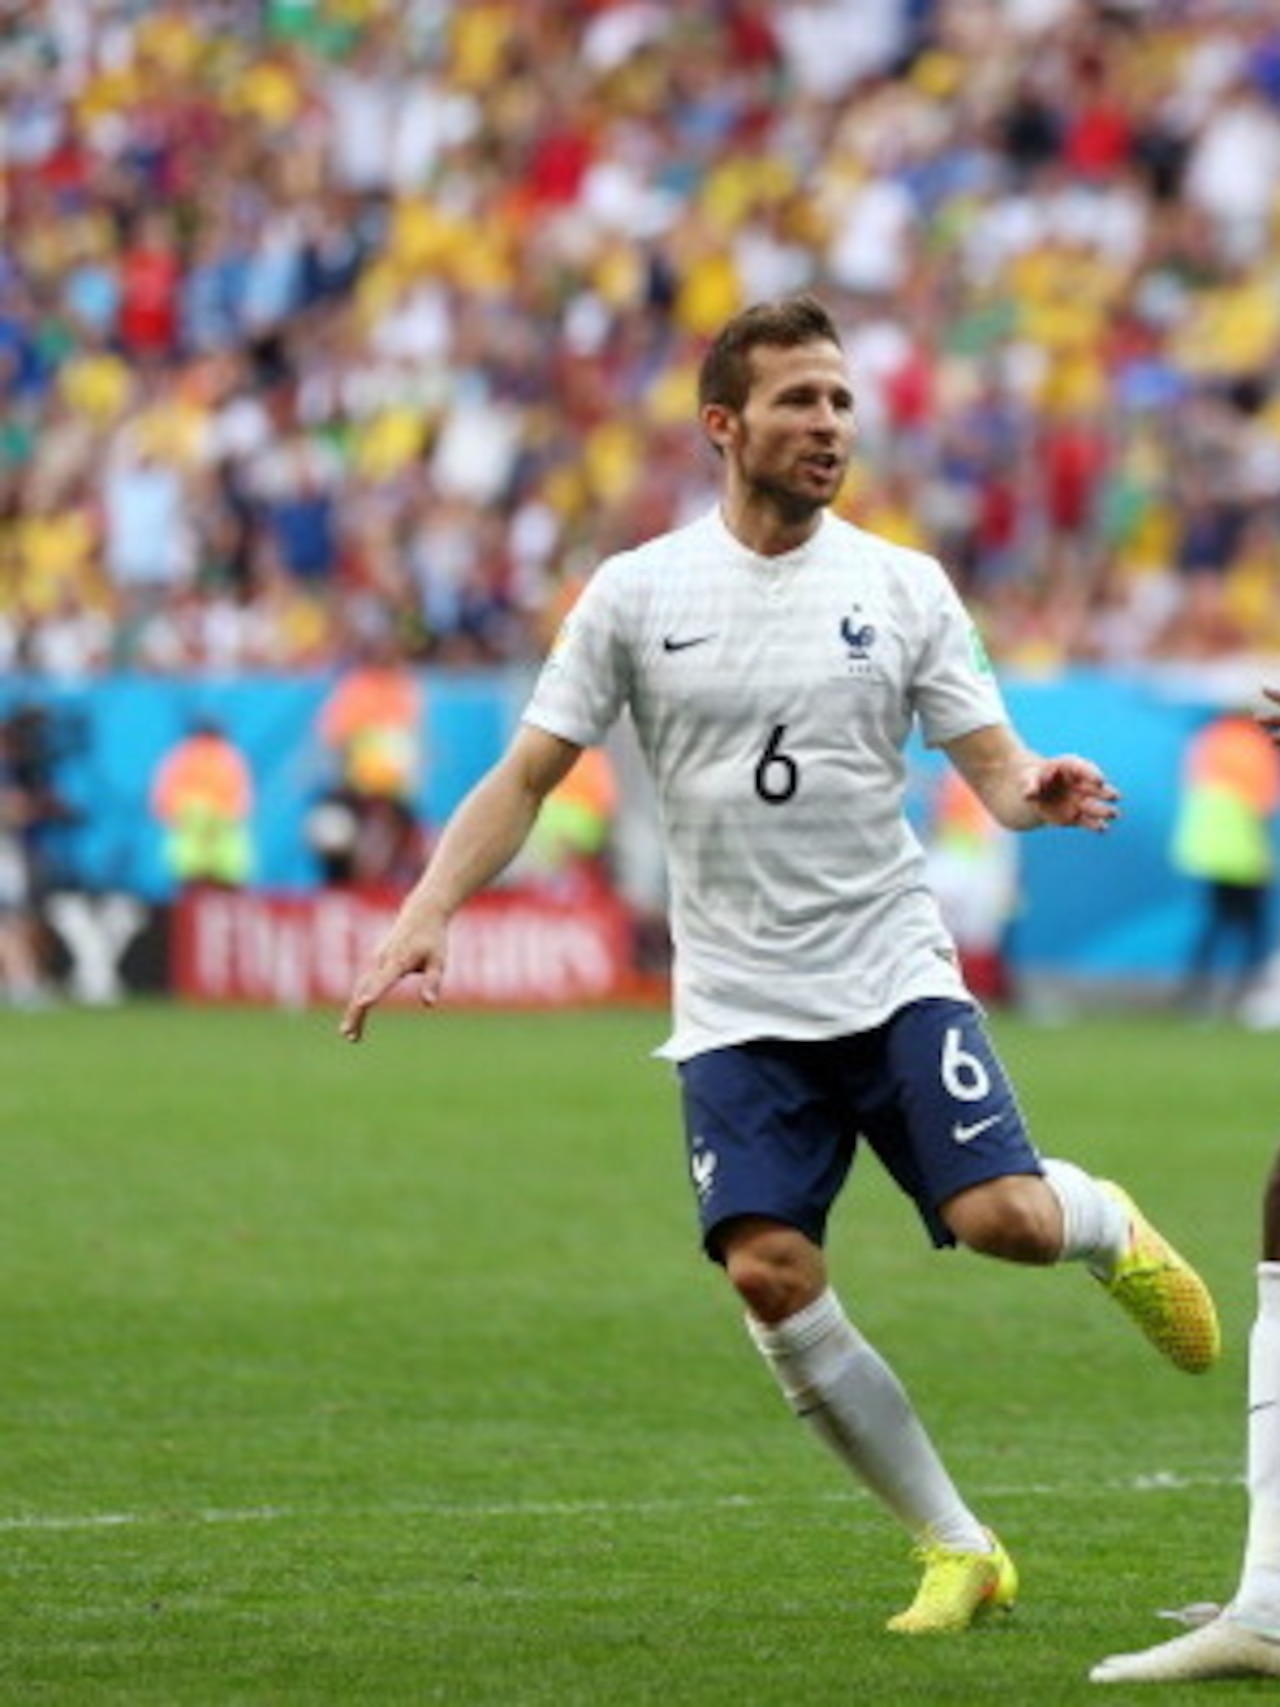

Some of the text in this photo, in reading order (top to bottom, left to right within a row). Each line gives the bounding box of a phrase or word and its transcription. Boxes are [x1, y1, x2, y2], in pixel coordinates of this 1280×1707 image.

[754, 724, 798, 804] 6
[314, 891, 611, 998] Emrates
[940, 1028, 990, 1101] 6
